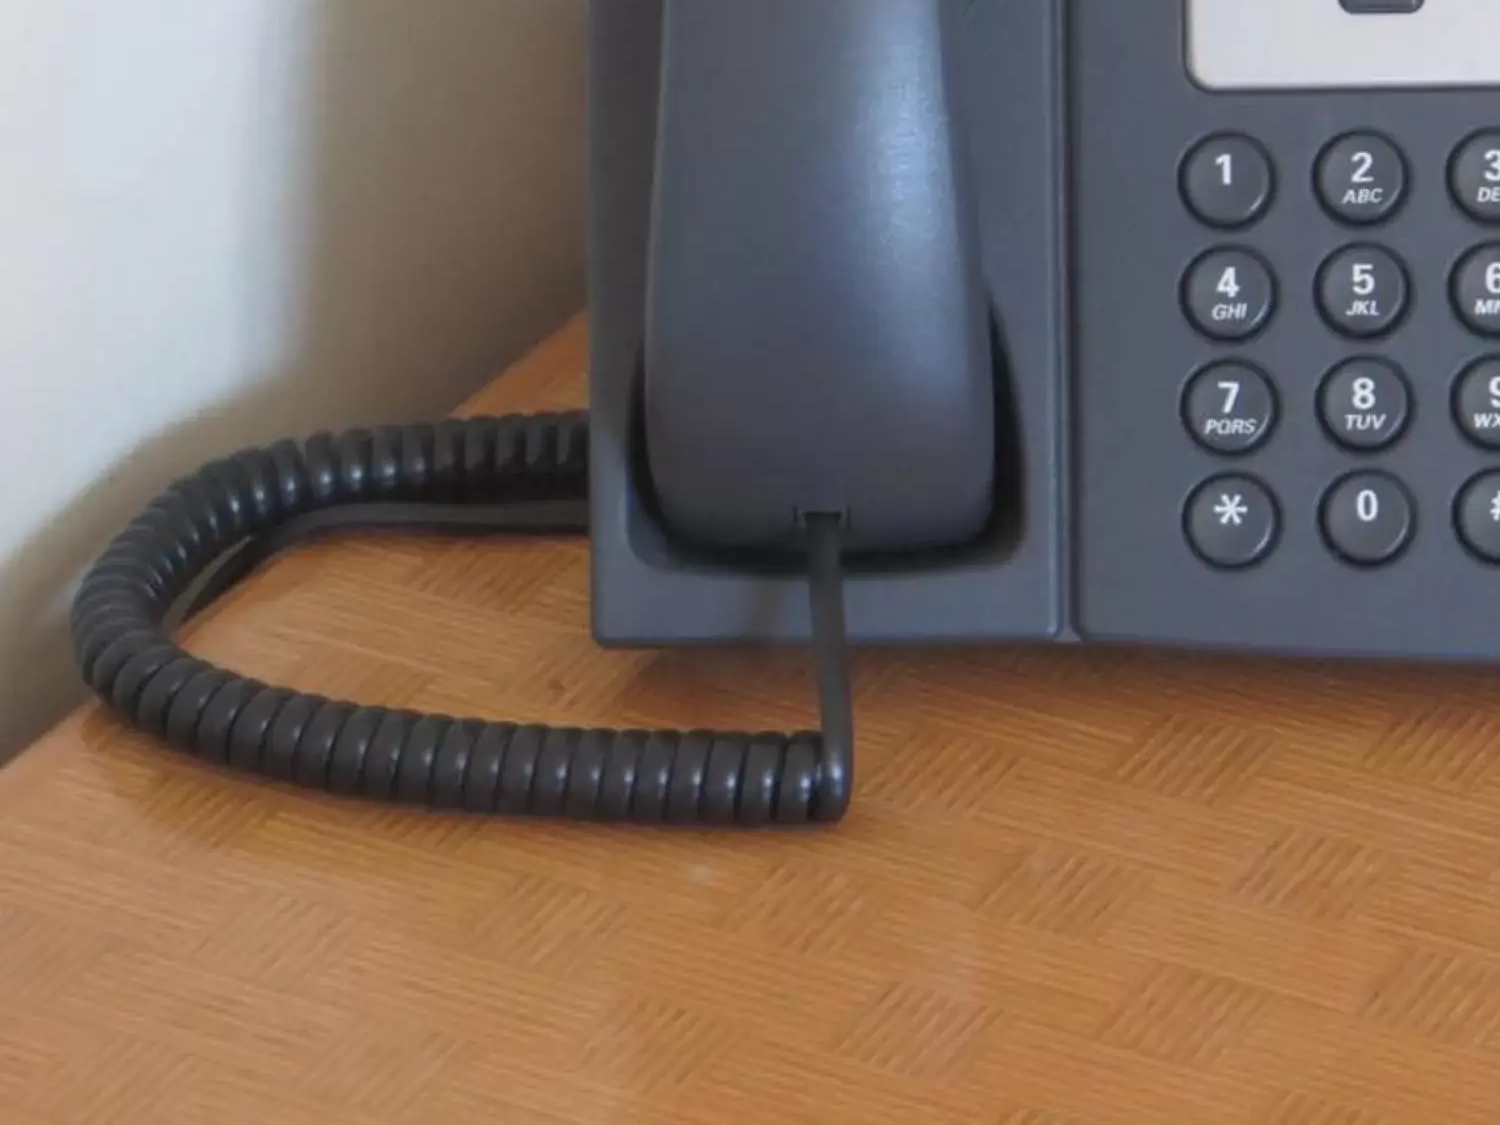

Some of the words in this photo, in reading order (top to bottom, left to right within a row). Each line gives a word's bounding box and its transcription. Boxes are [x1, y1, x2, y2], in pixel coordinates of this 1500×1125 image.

[1214, 154, 1233, 185] 1
[1350, 151, 1374, 182] 2
[1342, 188, 1384, 205] ABC
[1216, 266, 1240, 298] 4
[1351, 263, 1375, 294] 5
[1211, 302, 1248, 321] GHI
[1346, 299, 1380, 316] JKL
[1216, 381, 1240, 413] 7
[1351, 377, 1376, 409] 8
[1204, 417, 1257, 435] PQRS
[1344, 413, 1386, 430] TUV
[1356, 489, 1379, 522] 0
